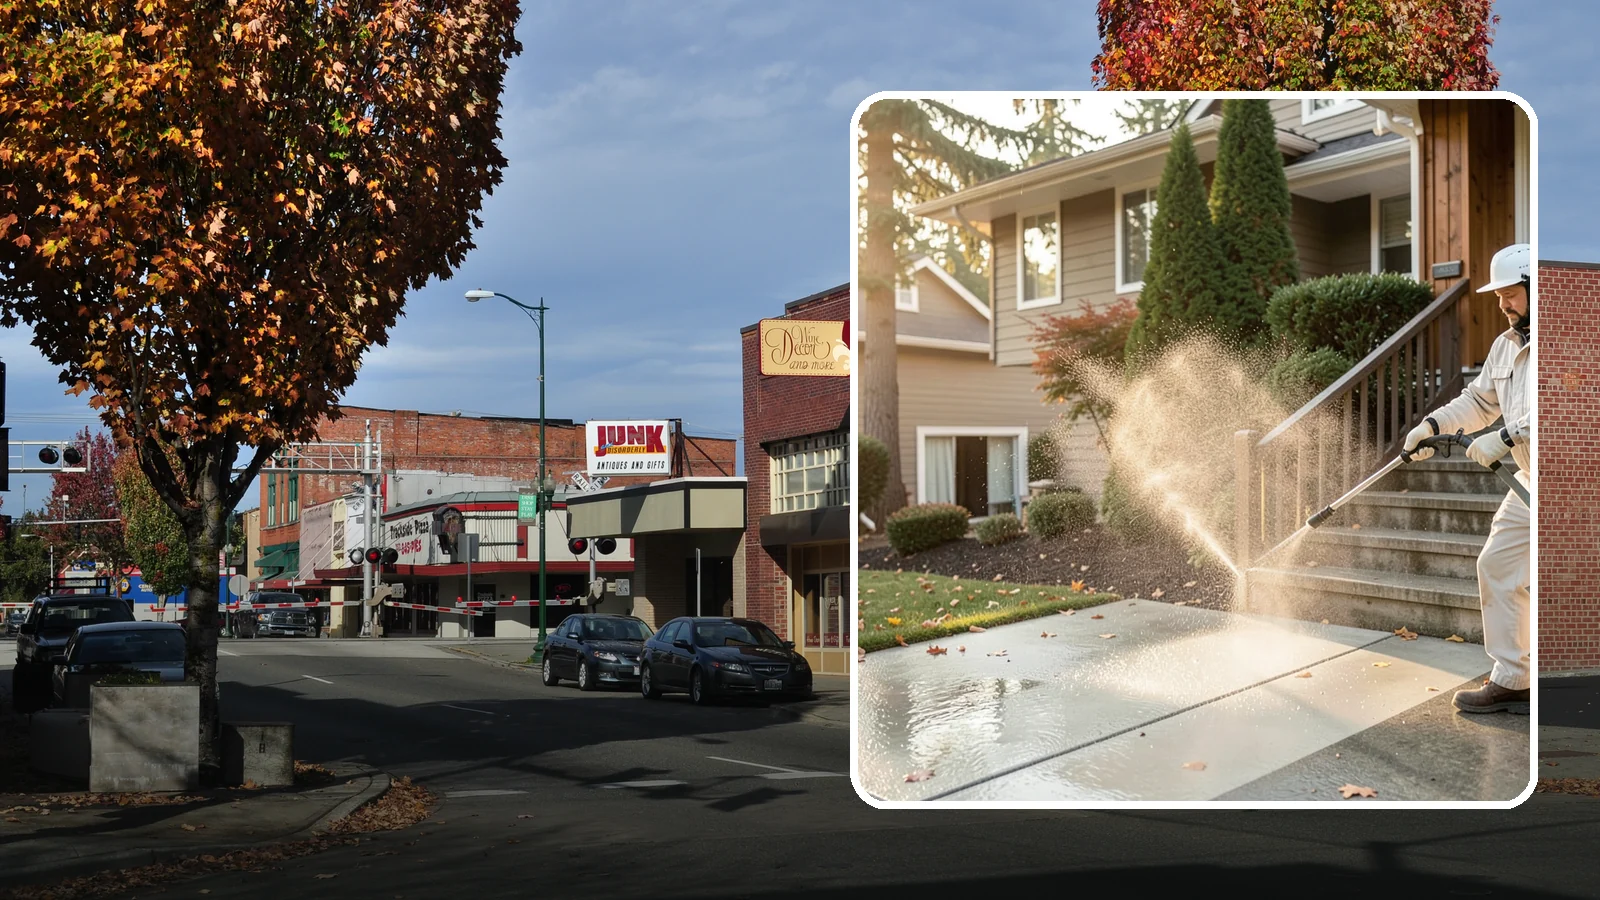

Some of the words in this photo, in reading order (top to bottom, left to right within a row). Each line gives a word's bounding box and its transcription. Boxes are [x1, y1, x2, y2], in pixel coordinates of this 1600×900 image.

[595, 425, 665, 457] JUNK
[607, 446, 646, 454] DISORDERLY
[596, 460, 628, 470] ANTIQUES
[631, 460, 644, 470] AND
[647, 460, 665, 469] GIFTS
[390, 521, 413, 540] Trackside
[414, 519, 429, 534] Pizza
